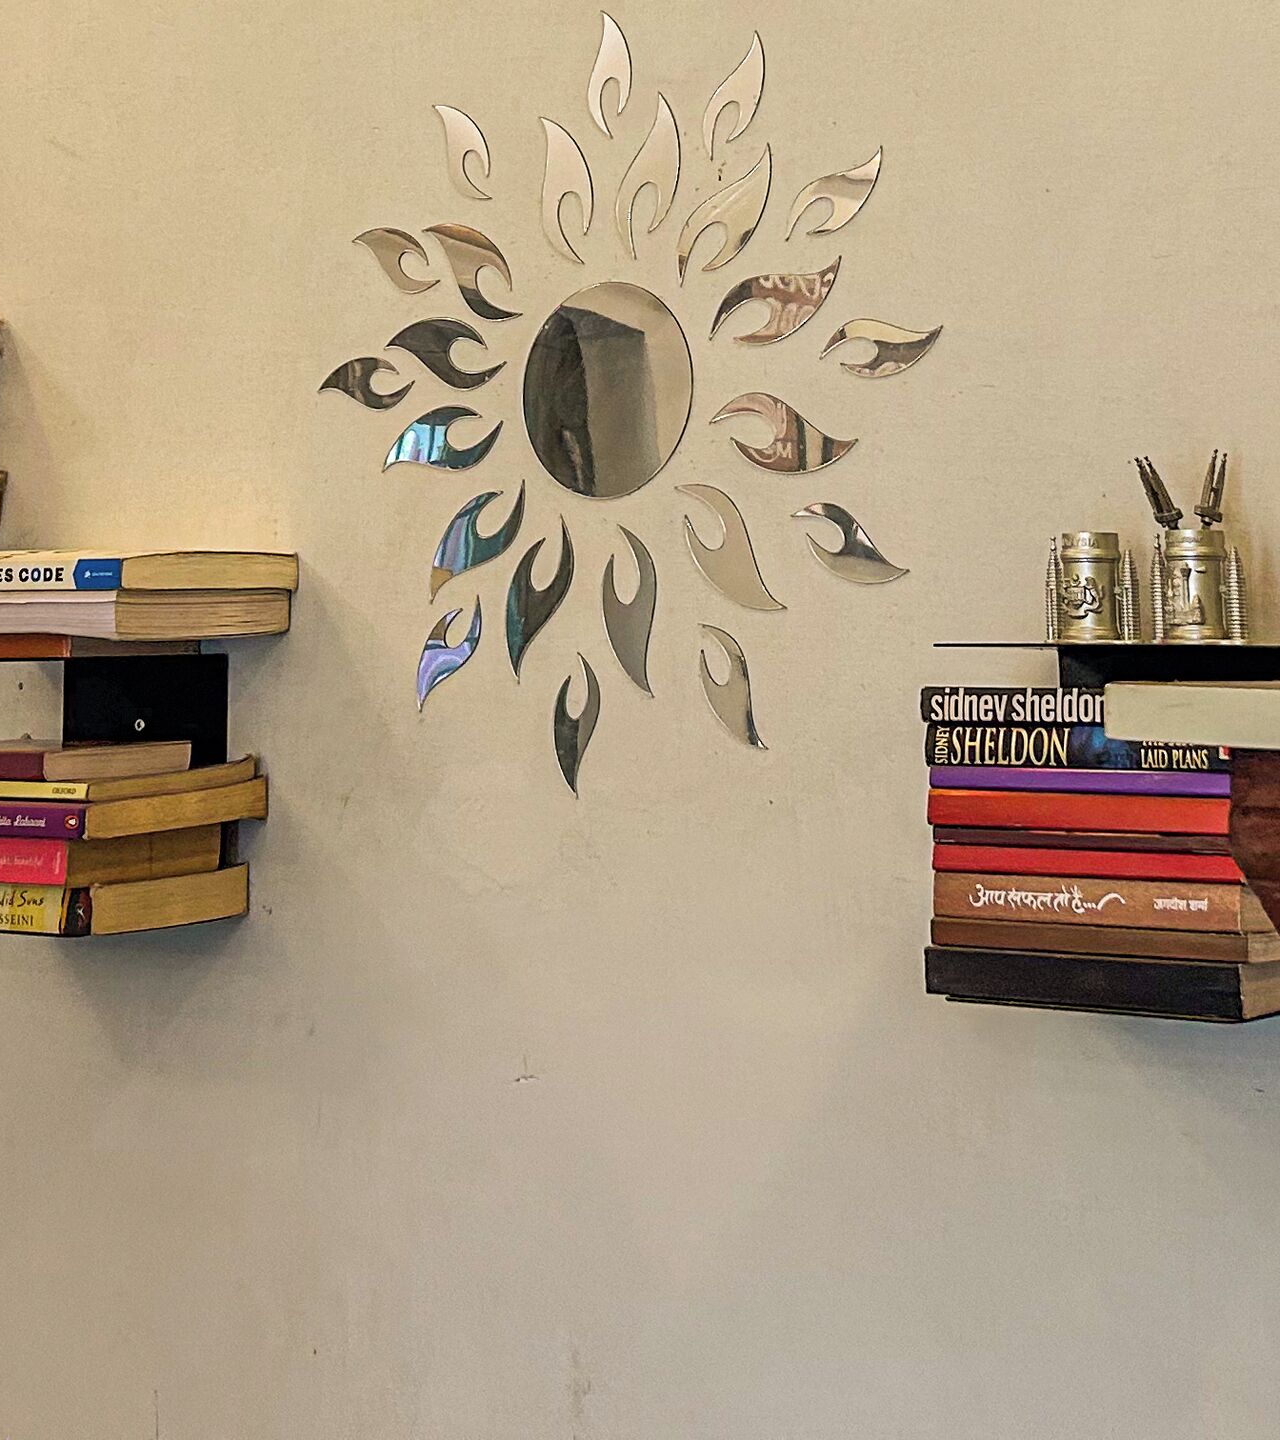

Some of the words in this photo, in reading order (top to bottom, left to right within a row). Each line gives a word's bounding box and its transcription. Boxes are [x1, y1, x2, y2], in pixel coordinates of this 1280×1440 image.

[18, 567, 64, 582] CODE
[931, 687, 1007, 722] sidney
[935, 726, 950, 764] SIDNEY
[950, 727, 1070, 767] SHELDON
[1140, 749, 1168, 769] LAID
[1172, 750, 1209, 769] PLANS
[17, 891, 44, 907] Suns
[969, 883, 1006, 908] आप
